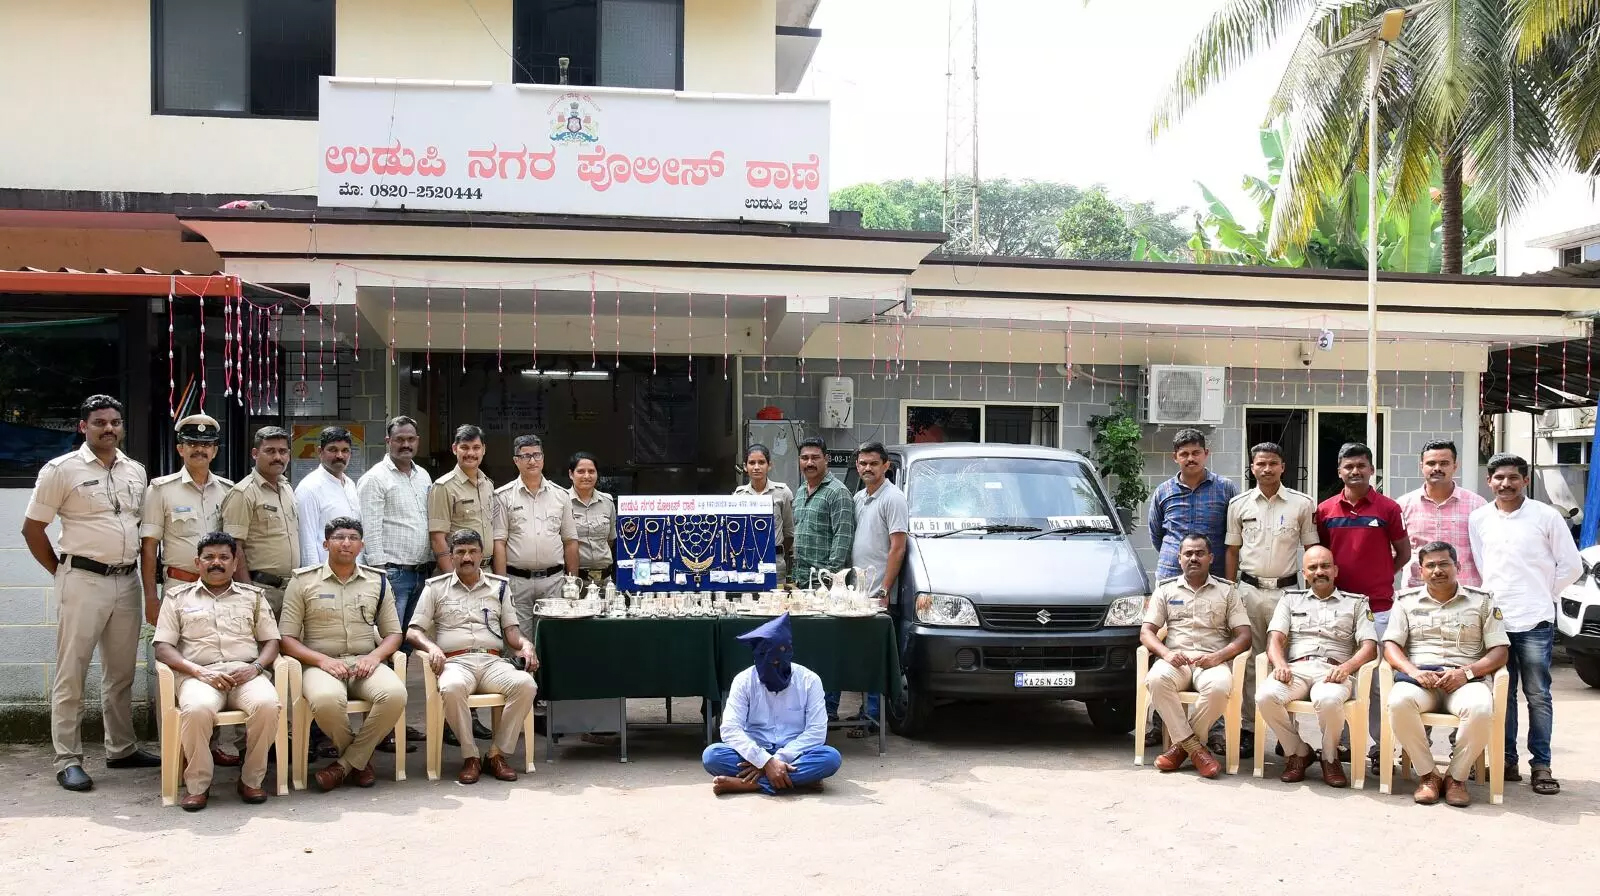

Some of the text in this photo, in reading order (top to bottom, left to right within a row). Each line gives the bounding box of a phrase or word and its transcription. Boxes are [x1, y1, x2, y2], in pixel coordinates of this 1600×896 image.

[325, 138, 820, 192] ಉಡುಪಿ ನಗರ ಪೊಲೀಸ್ ಠಾಣೆ
[370, 184, 483, 200] 0820-2520444
[744, 196, 808, 216] ಉಡುಪಿ ಜಿಲ್ಲೆ
[913, 521, 925, 531] KA
[929, 521, 940, 531] 51
[1048, 519, 1061, 530] KA
[1063, 519, 1074, 529] 51
